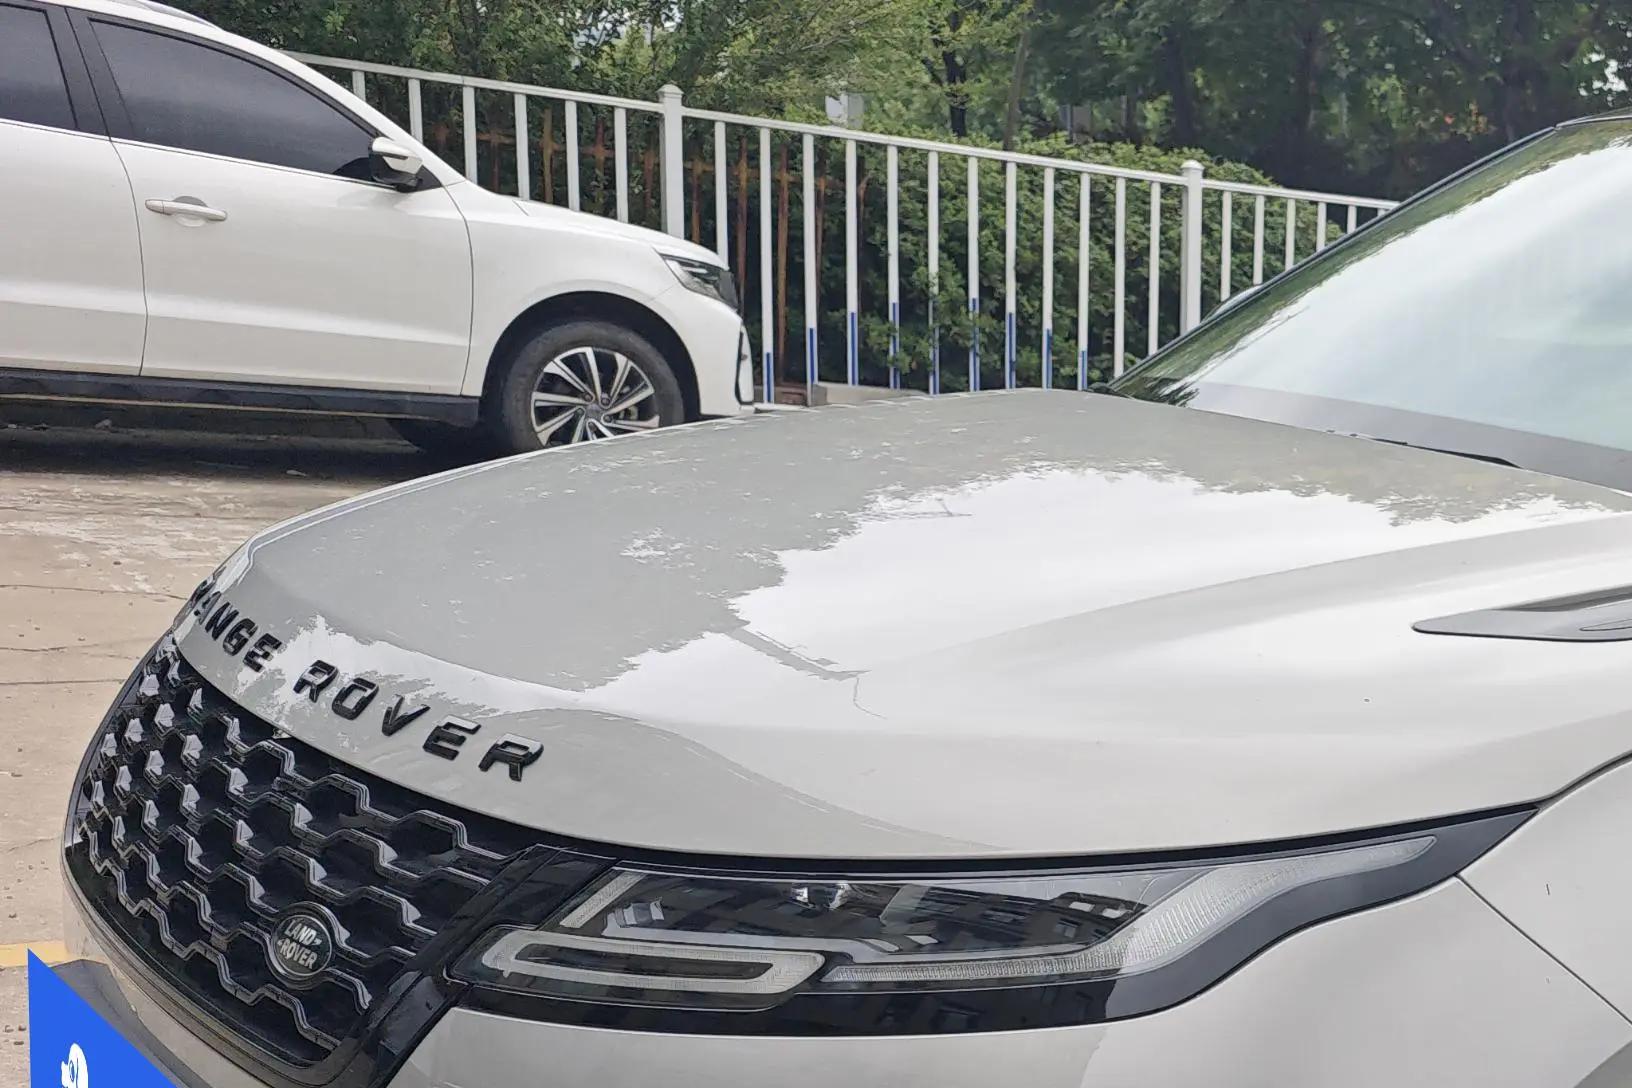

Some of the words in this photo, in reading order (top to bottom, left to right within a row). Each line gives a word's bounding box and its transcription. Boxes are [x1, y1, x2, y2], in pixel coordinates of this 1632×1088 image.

[294, 659, 544, 782] ROVER
[284, 919, 318, 946] LAND
[279, 938, 318, 970] ROVER
